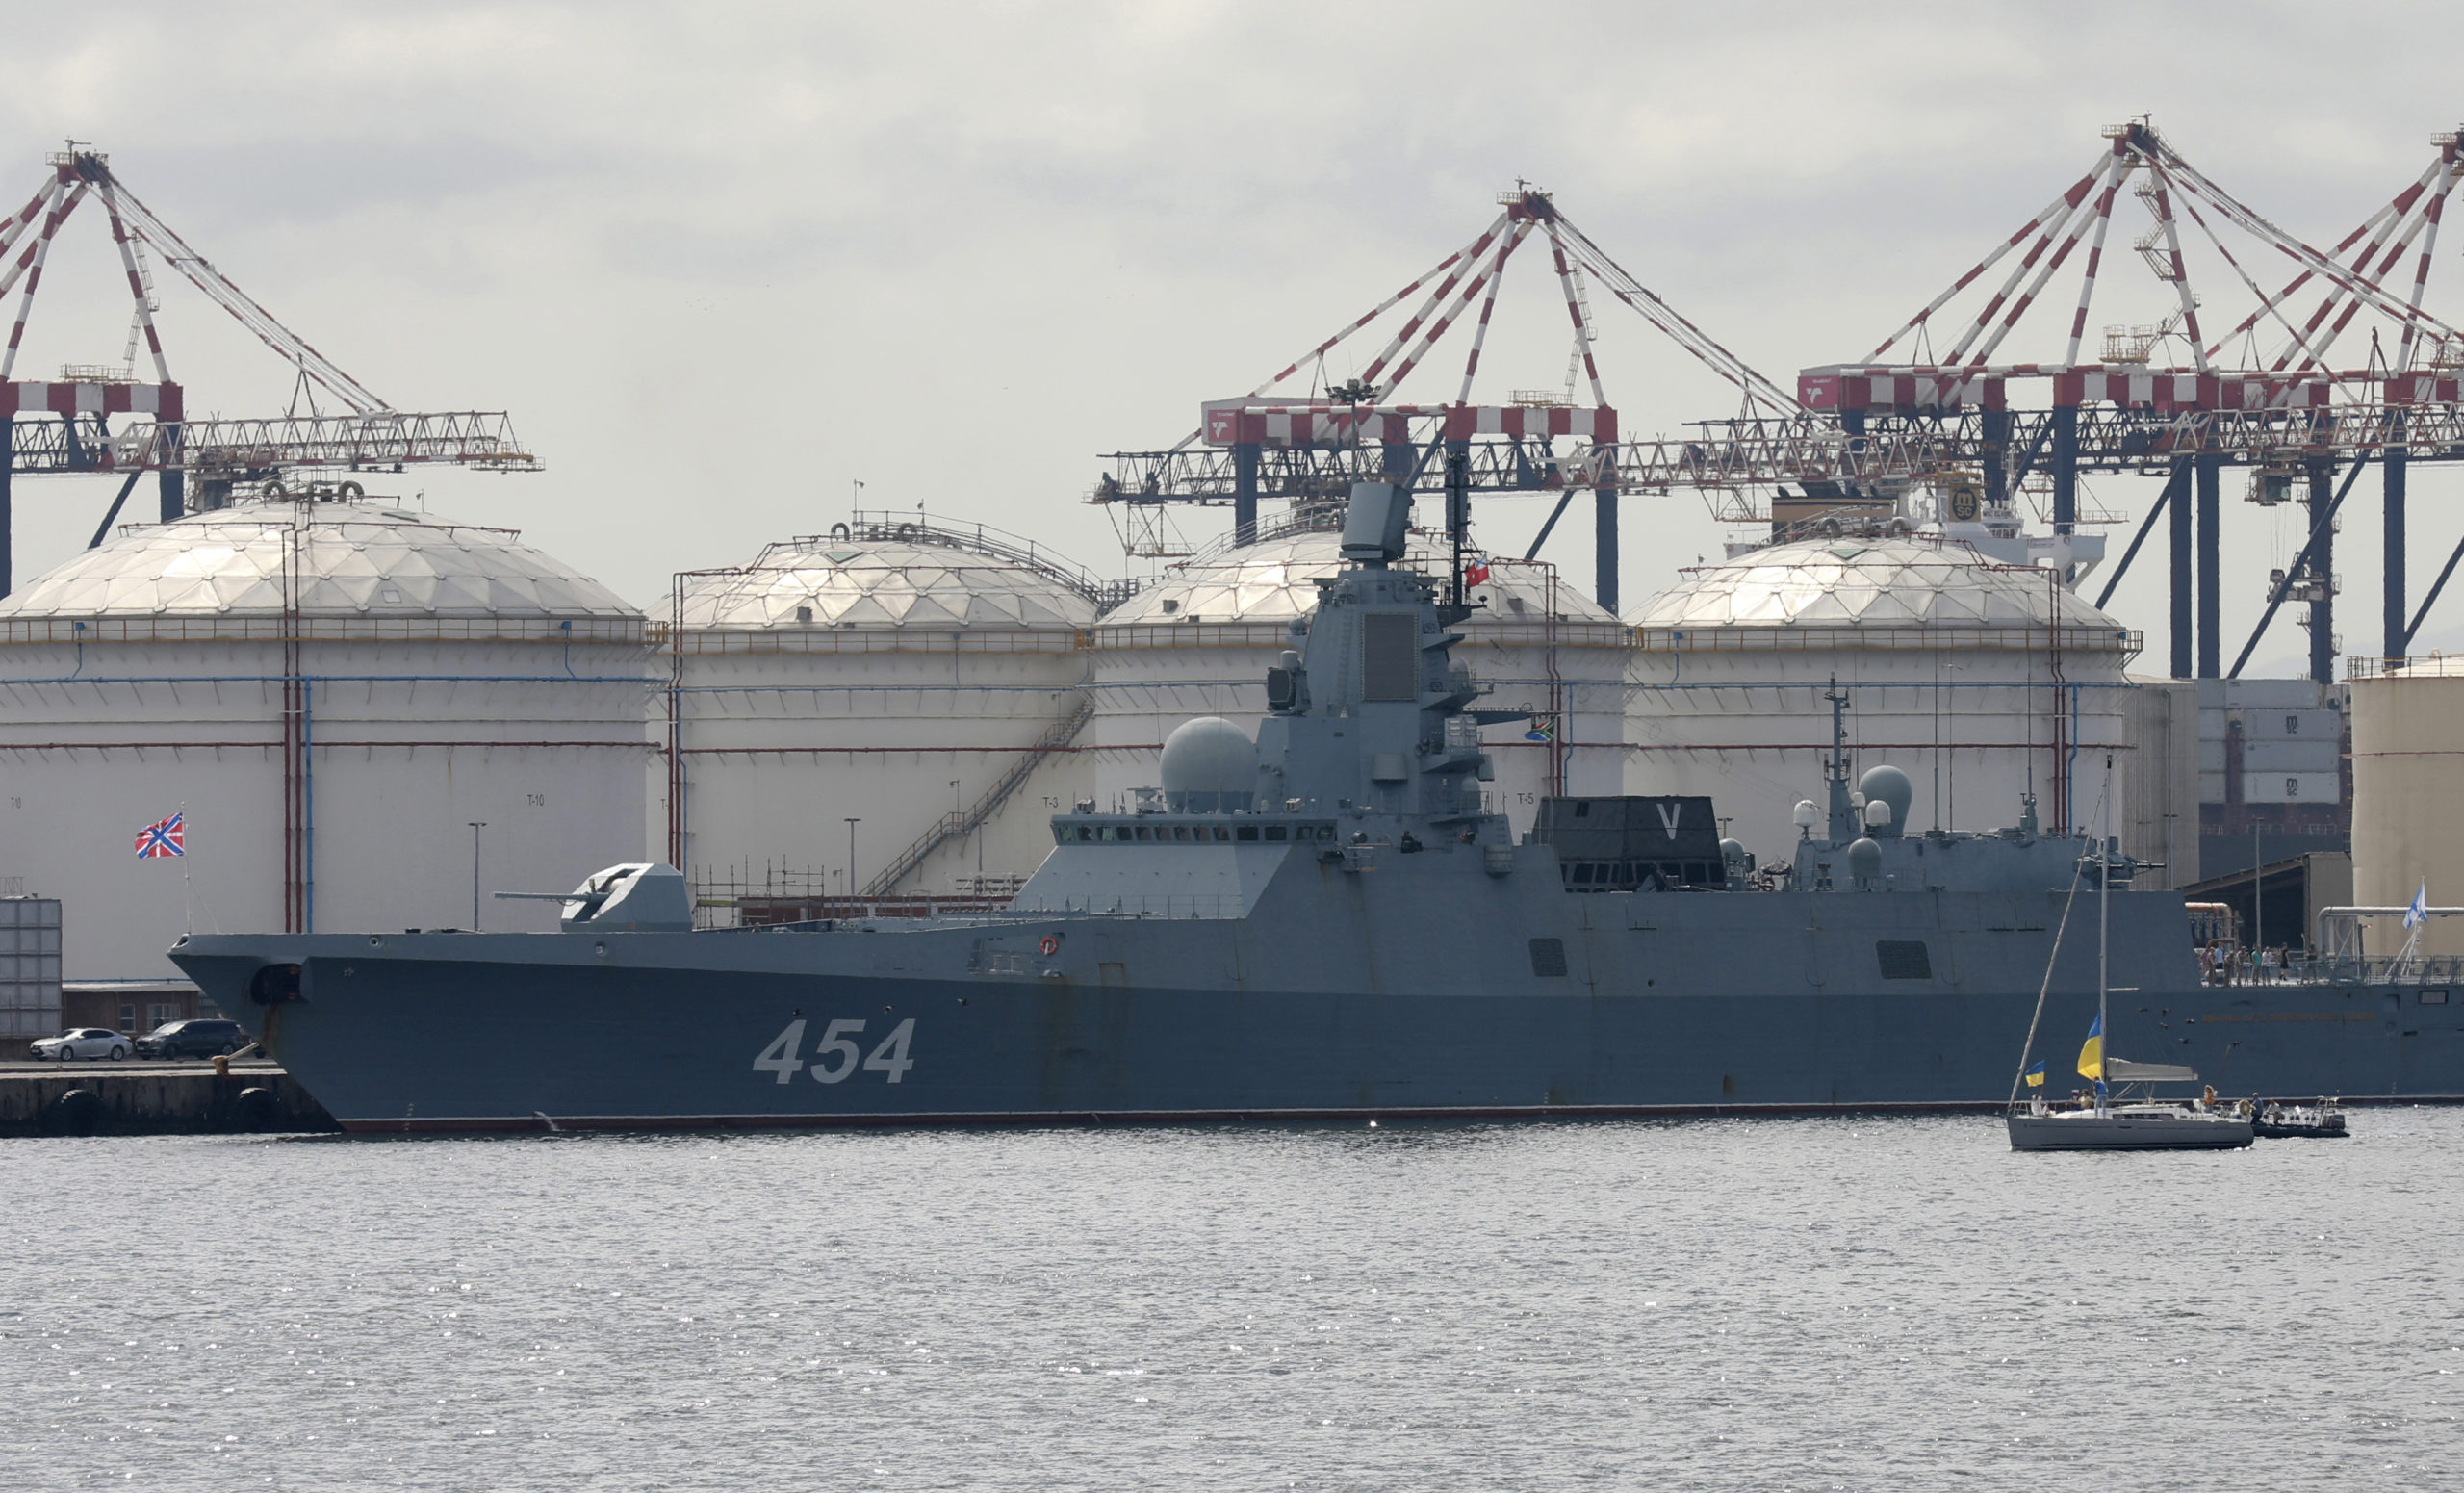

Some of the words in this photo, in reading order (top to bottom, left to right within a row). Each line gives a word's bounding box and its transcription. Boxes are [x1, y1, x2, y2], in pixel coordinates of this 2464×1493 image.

[526, 794, 545, 807] T-10
[1041, 796, 1059, 810] T-3
[1517, 792, 1534, 805] T-5
[1656, 803, 1681, 840] V
[752, 1018, 916, 1084] 454
